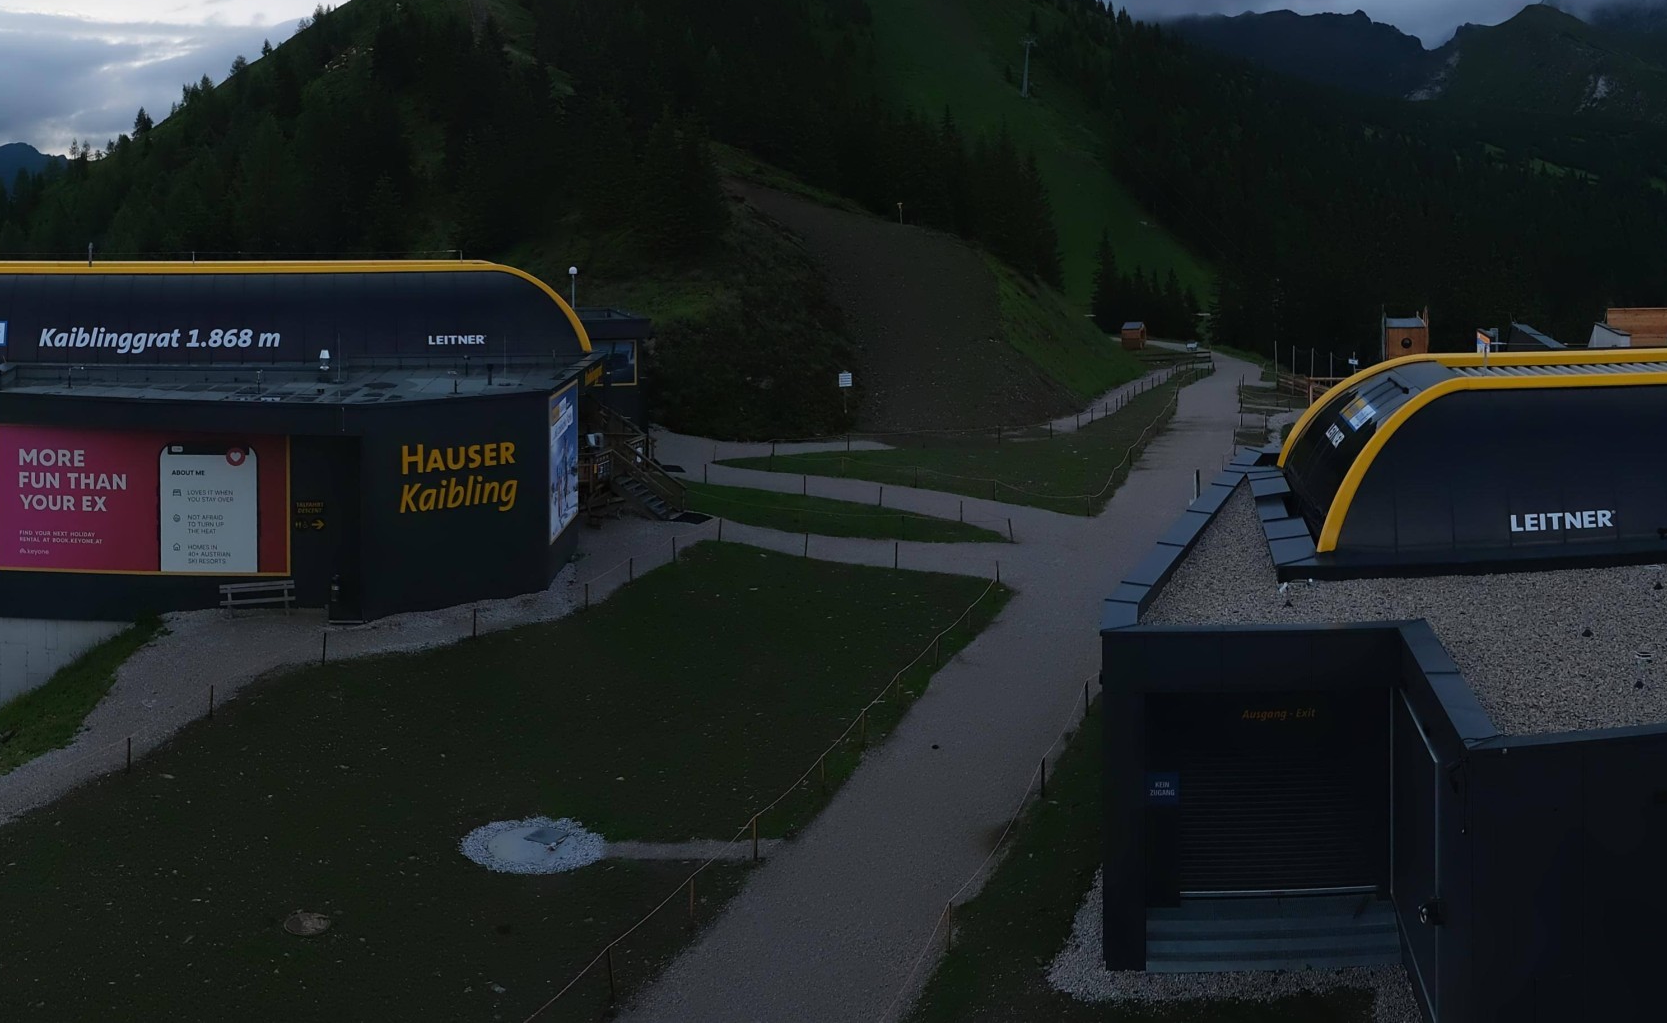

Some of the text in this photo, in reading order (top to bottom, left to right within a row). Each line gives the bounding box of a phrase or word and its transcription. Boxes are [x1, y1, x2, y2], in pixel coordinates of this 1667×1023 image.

[38, 327, 280, 354] Kaiblinggrat 1.868 m
[428, 335, 485, 345] LEITNER
[19, 449, 85, 467] MORE
[402, 441, 516, 475] HAUSER
[19, 472, 126, 490] FUN THAN
[20, 494, 107, 512] YOUR EX
[400, 475, 518, 514] Kaibling
[1510, 510, 1613, 532] LEITNER
[1241, 710, 1288, 721] Ausgang
[1296, 708, 1316, 718] Exit
